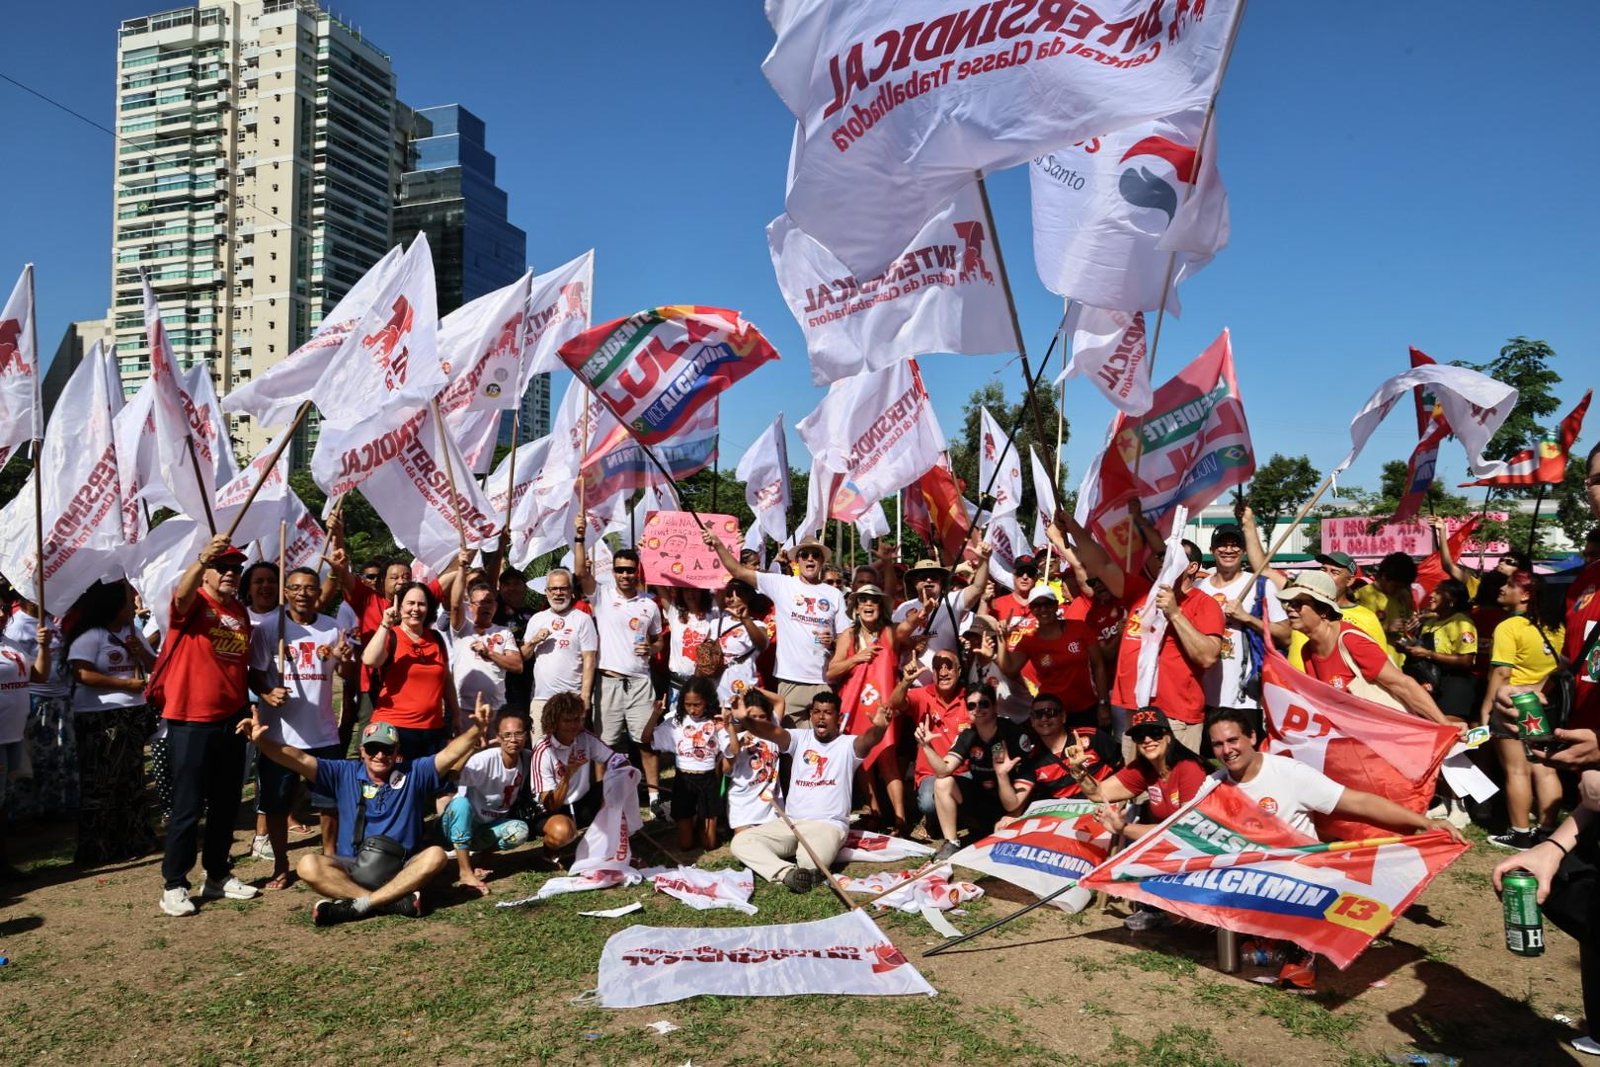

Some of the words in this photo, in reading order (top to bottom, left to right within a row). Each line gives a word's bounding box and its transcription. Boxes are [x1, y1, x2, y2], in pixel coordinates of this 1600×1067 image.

[1043, 155, 1086, 192] Santo
[644, 401, 666, 428] VICE
[663, 344, 729, 412] ALCKMIN
[994, 841, 1018, 858] VICE
[1016, 846, 1095, 876] ALCKMIN
[1183, 867, 1330, 908] ALCKMIN
[1336, 895, 1380, 921] 13
